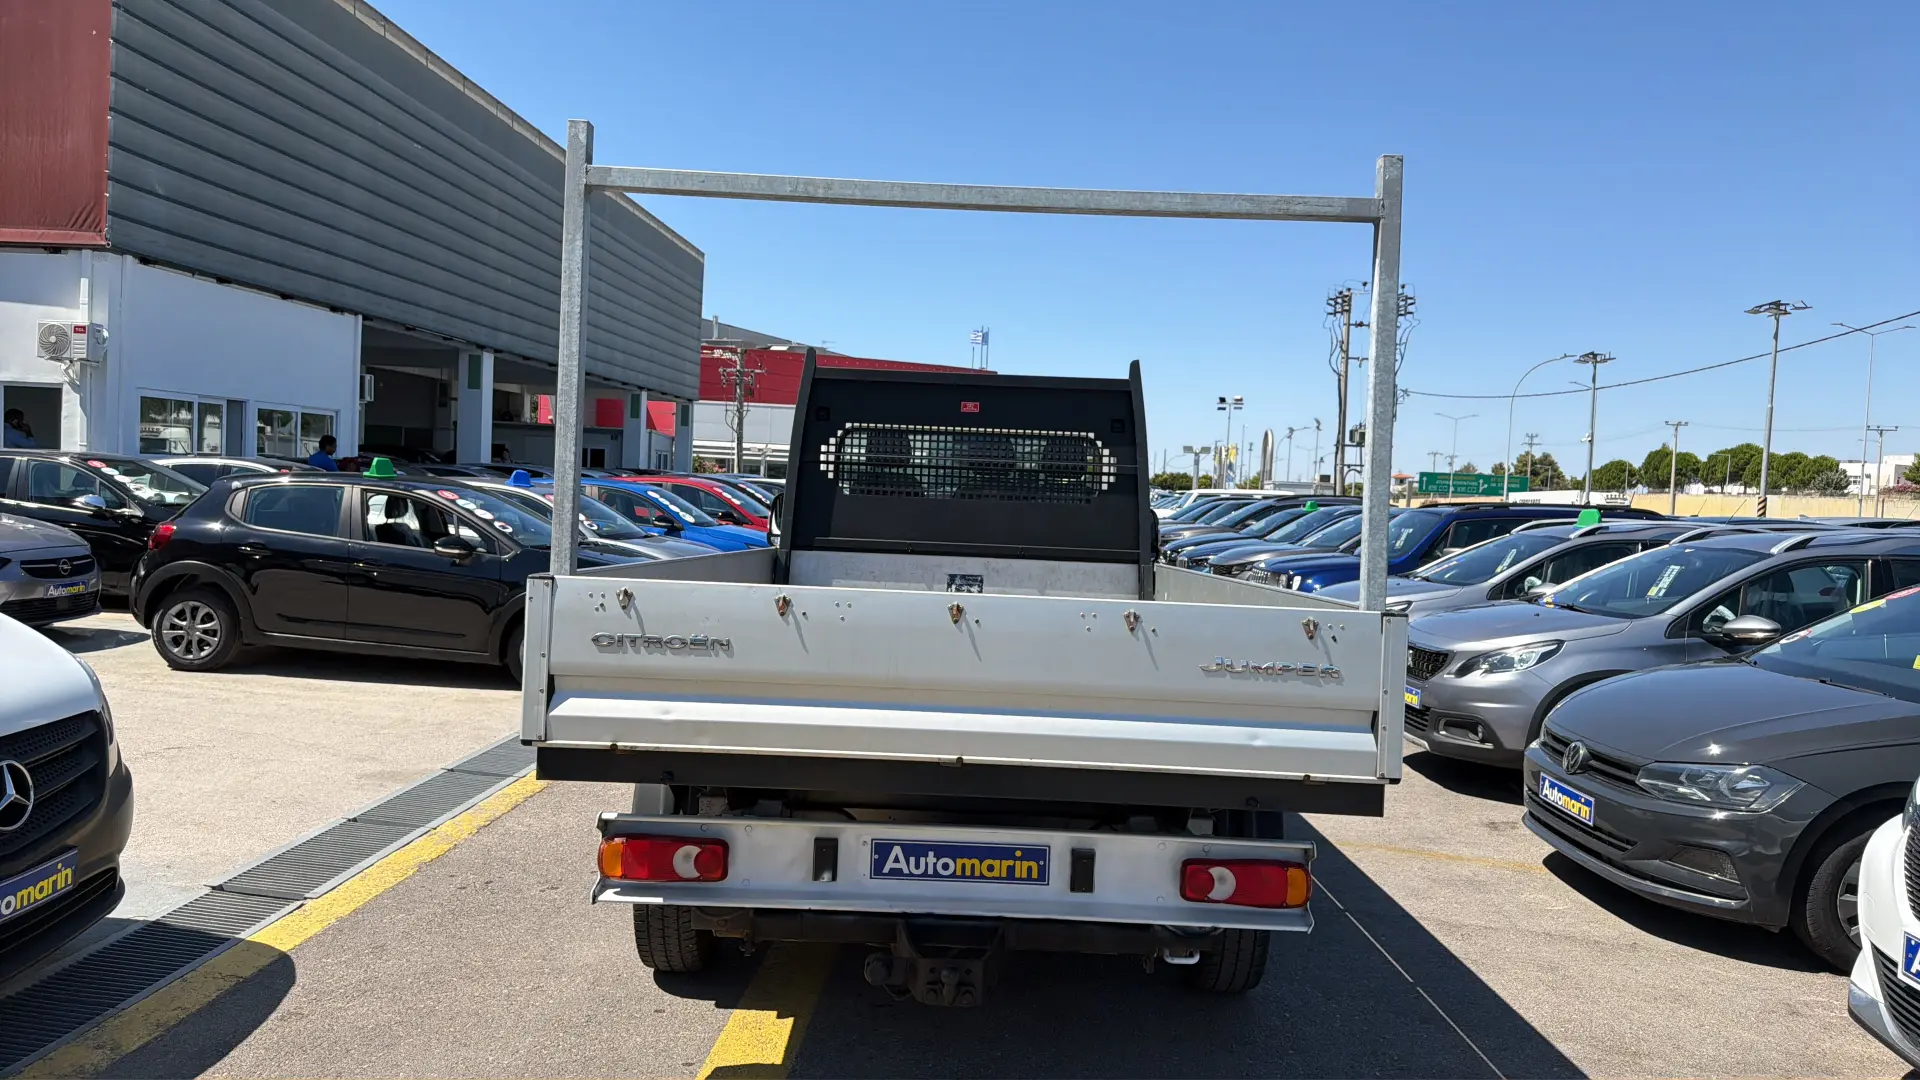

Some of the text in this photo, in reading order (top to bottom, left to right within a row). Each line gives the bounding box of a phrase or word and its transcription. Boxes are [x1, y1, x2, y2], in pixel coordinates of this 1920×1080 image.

[47, 582, 86, 596] Automarin
[591, 632, 731, 651] CITROËN
[1199, 655, 1341, 679] JUMPER
[1542, 779, 1590, 820] Automarin
[882, 845, 1039, 879] Automarin
[0, 862, 73, 915] omarin
